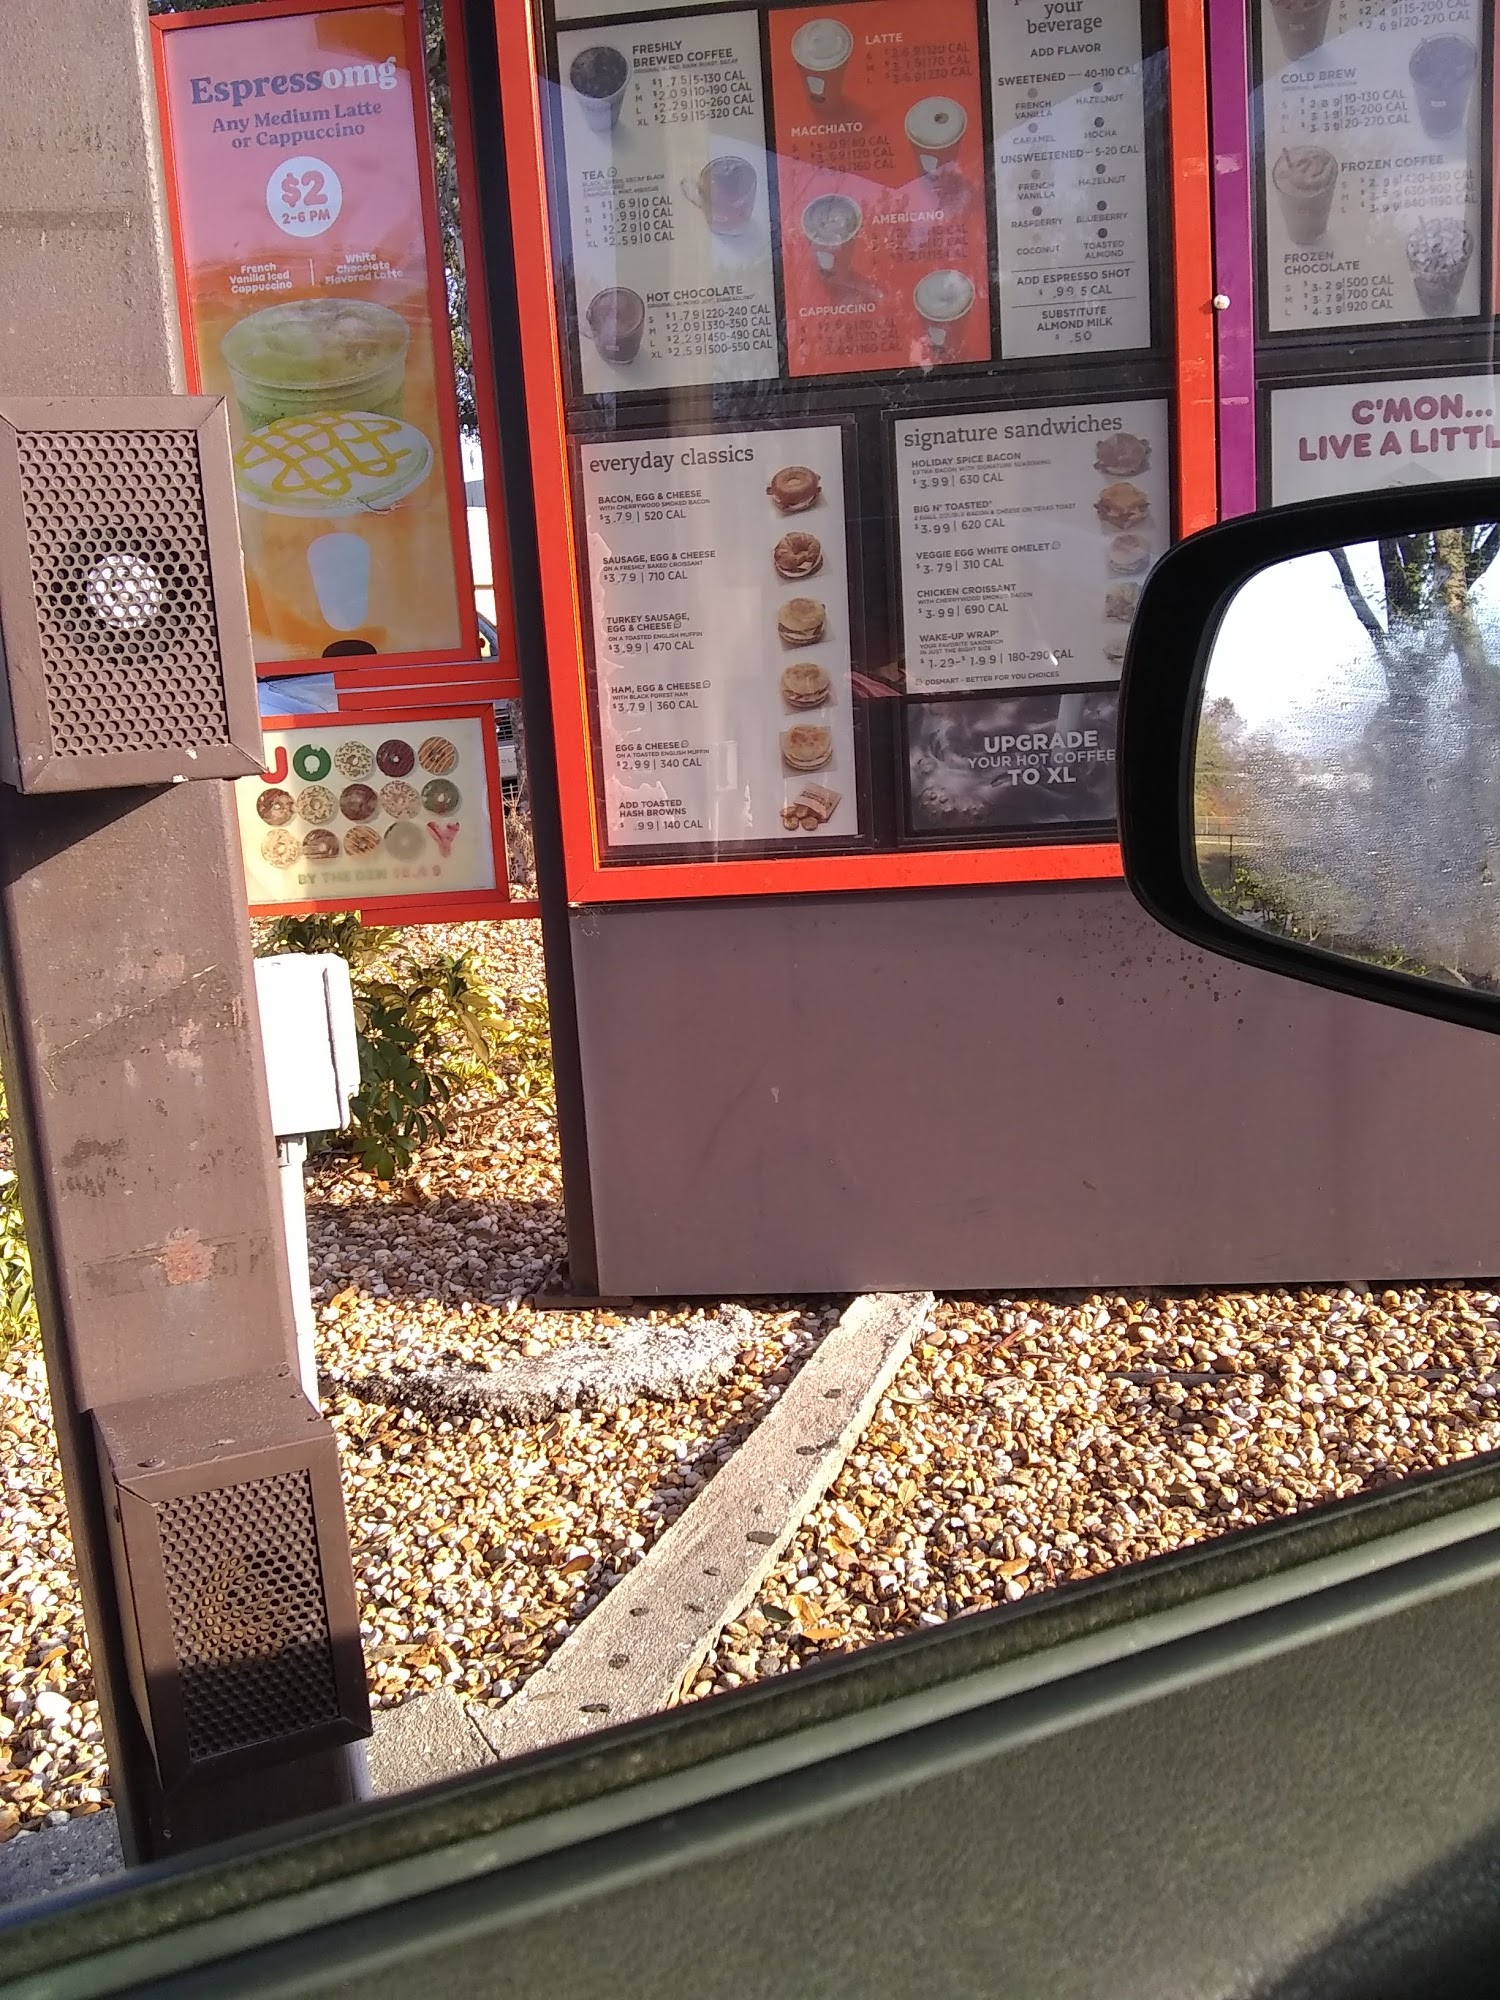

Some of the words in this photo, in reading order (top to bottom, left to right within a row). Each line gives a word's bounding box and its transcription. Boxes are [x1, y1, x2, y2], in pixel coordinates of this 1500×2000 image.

[1044, 1, 1083, 18] your
[1027, 17, 1102, 34] beverage
[865, 33, 903, 44] LATTE
[632, 41, 682, 54] FRESHLY
[1031, 48, 1054, 57] ADD
[1058, 43, 1101, 55] FLAVOR
[633, 55, 684, 68] BREWED
[687, 49, 732, 62] COFFEE
[190, 57, 398, 106] Espressomg
[725, 70, 745, 81] CAL
[998, 72, 1065, 86] SWEETENED
[1281, 72, 1314, 84] COLD
[1319, 68, 1357, 80] BREW
[730, 83, 751, 93] CAL
[1076, 94, 1123, 104] HAZELNUT
[1016, 101, 1051, 110] FRENCH
[212, 118, 250, 133] Any
[254, 109, 330, 128] Medium
[335, 102, 382, 118] Latte
[1015, 111, 1052, 119] VANILLA
[791, 122, 862, 136] MACCHIATO
[1084, 130, 1116, 138] MOCHA
[231, 136, 249, 148] or
[256, 123, 365, 148] Cappuccino
[1013, 136, 1055, 144] CARAMEL
[1001, 150, 1083, 164] UNSWEETENED
[1121, 145, 1138, 154] CAL
[1341, 158, 1391, 172] FROZEN
[1396, 154, 1444, 167] COFFEE
[582, 170, 604, 180] TEA
[1079, 175, 1126, 186] HAZELNUT
[281, 171, 328, 207] $2
[1019, 182, 1054, 190] FRENCH
[1017, 192, 1055, 200] VANILLA
[282, 212, 306, 224] 2-6
[310, 210, 330, 221] PM
[653, 208, 673, 217] CAL
[872, 210, 944, 224] AMERICANO
[1077, 213, 1127, 223] BLUEBERRY
[653, 220, 674, 229] CAL
[1012, 218, 1063, 228] RASPBERRY
[1017, 245, 1059, 255] COCONUT
[1084, 240, 1124, 249] TOASTED
[345, 252, 376, 262] White
[1085, 250, 1123, 259] ALMOND
[1284, 252, 1334, 263] FROZEN
[241, 262, 276, 273] French
[336, 261, 390, 273] Chocolate
[1284, 261, 1360, 275] CHOCOLATE
[229, 272, 264, 284] Vanilla
[267, 271, 289, 281] Iced
[325, 272, 371, 284] Flavored
[374, 269, 402, 280] Latte
[1017, 276, 1039, 285] ADD
[1044, 272, 1098, 283] ESPRESSO
[1102, 269, 1131, 279] SHOT
[231, 281, 292, 293] Cappuccino
[647, 292, 669, 302] HOT
[674, 285, 743, 299] CHOCOLATE
[799, 303, 876, 317] CAPPUCCINO
[1042, 306, 1107, 319] SUBSTITUTE
[1037, 320, 1083, 331] ALMOND
[1087, 317, 1112, 327] MILK
[1352, 394, 1493, 425] C'MON...
[904, 428, 997, 451] signature
[1004, 415, 1122, 439] sandwiches
[1300, 434, 1371, 461] LIVE
[1380, 431, 1402, 455] A
[590, 451, 674, 475] everyday
[680, 445, 754, 465] classics
[912, 458, 953, 468] HOLIDAY
[956, 455, 984, 465] SPICE
[986, 453, 1021, 462] BACON
[960, 475, 980, 485] 630
[983, 473, 1004, 483] CAL
[598, 494, 633, 504] BACON,
[636, 493, 654, 501] EGG
[666, 490, 702, 499] CHEESE
[617, 502, 660, 510] CHERRYWOOD
[913, 504, 936, 513] BIG
[645, 511, 663, 520] 520
[666, 509, 686, 519] CAL
[961, 520, 981, 530] 620
[985, 518, 1005, 528] CAL
[603, 555, 647, 564] SAUSAGE,
[650, 554, 669, 562] EGG
[680, 550, 716, 559] CHEESE
[916, 551, 951, 560] VEGGIE
[954, 549, 973, 557] EGG
[977, 546, 1008, 555] WHITE
[1011, 543, 1049, 553] OMELET
[963, 560, 980, 570] 310
[984, 558, 1004, 568] CAL
[648, 572, 665, 581] 710
[668, 571, 688, 580] CAL
[917, 588, 959, 598] CHICKEN
[962, 584, 1016, 594] CROISSANT
[965, 605, 985, 615] 690
[988, 603, 1008, 613] CAL
[607, 616, 642, 624] TURKEY
[644, 613, 689, 622] SAUSAGE,
[607, 625, 626, 633] EGG
[637, 622, 672, 631] CHEESE
[919, 632, 964, 642] WAKE-UP
[653, 642, 671, 651] 470
[675, 641, 694, 650] CAL
[1008, 651, 1049, 663] 180-290
[1053, 649, 1073, 660] CAL
[966, 674, 993, 683] BETTER
[995, 673, 1009, 681] FOR
[1011, 672, 1027, 680] YOU
[1028, 671, 1059, 679] CHOICES
[612, 685, 634, 694] HAM,
[637, 684, 655, 693] EGG
[666, 681, 701, 690] CHEESE
[657, 701, 675, 710] 360
[679, 700, 698, 709] CAL
[616, 743, 634, 752] EGG
[645, 741, 680, 750] CHEESE
[984, 730, 1098, 753] UPGRADE
[661, 759, 679, 768] 340
[682, 758, 701, 767] CAL
[968, 755, 1011, 768] YOUR
[1017, 753, 1049, 766] HOT
[1054, 749, 1115, 764] COFFEE
[1008, 768, 1040, 786] TO
[1047, 766, 1076, 784] XL
[619, 801, 638, 809] ADD
[641, 799, 682, 808] TOASTED
[620, 809, 644, 818] HASH
[647, 808, 686, 816] BROWNS
[664, 821, 680, 829] 140
[684, 820, 703, 829] CAL
